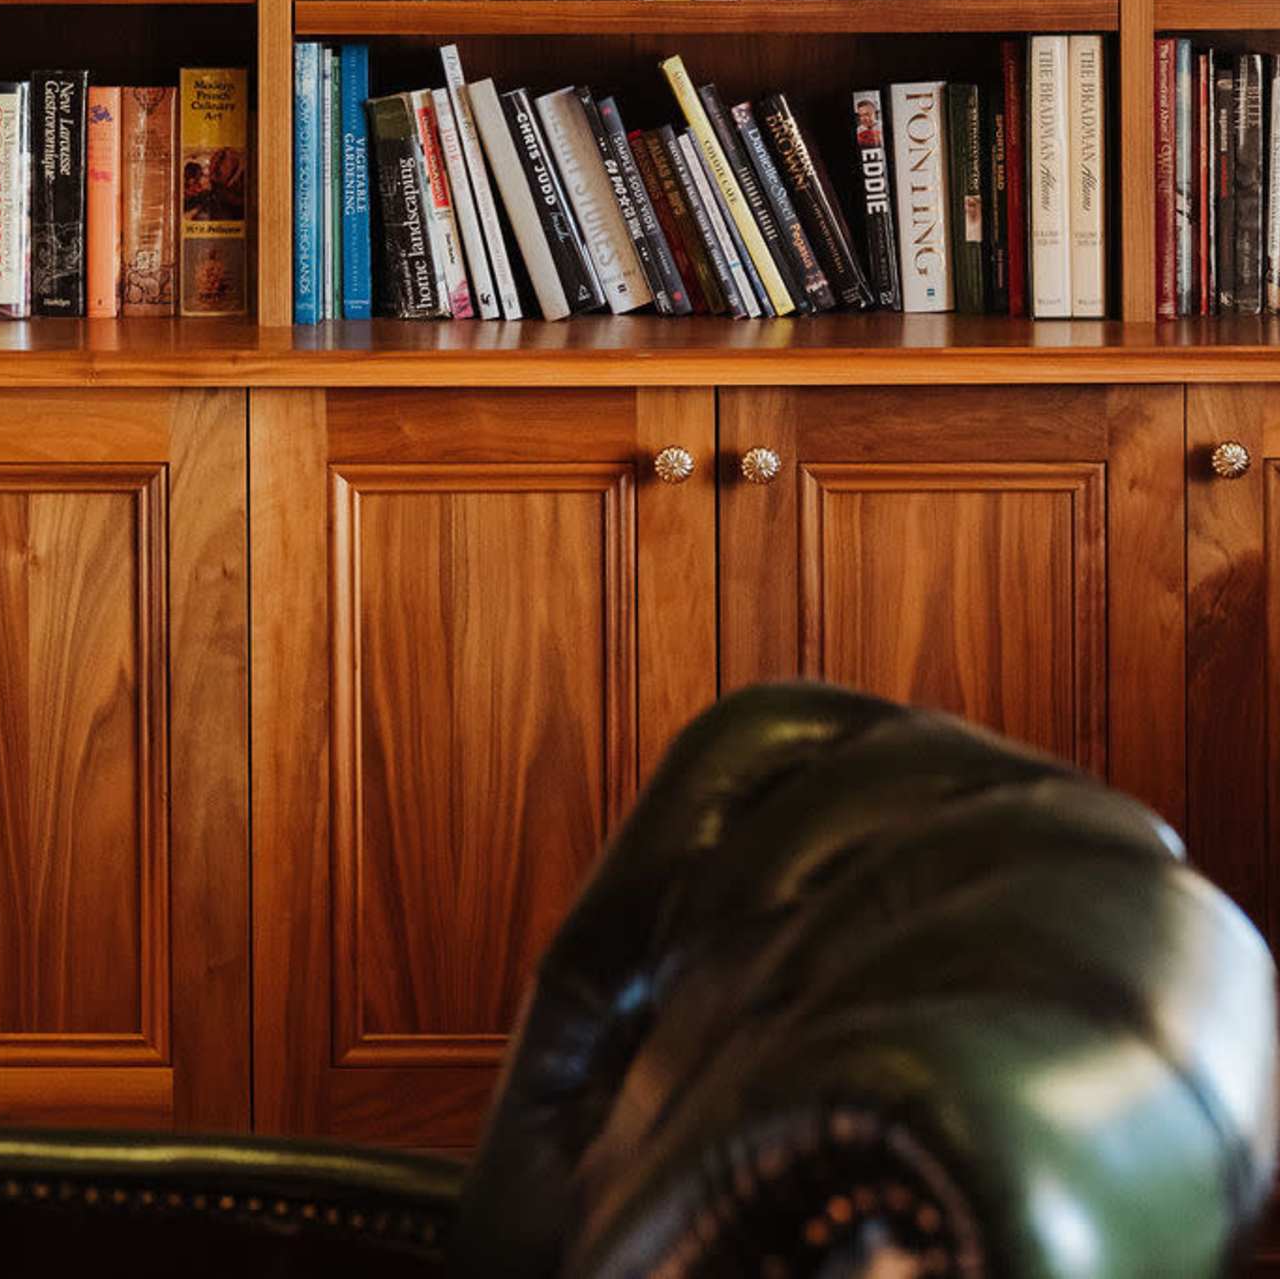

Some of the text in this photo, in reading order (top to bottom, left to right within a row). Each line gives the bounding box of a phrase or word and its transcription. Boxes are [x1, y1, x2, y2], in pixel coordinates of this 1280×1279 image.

[40, 80, 60, 184] Gastronomique
[59, 80, 75, 176] New Larousse
[190, 101, 237, 114] Culinary
[203, 113, 224, 122] Art
[1038, 48, 1057, 213] THE BRADMAN Albums
[1080, 48, 1098, 213] THE BRADMAN Albums
[344, 132, 356, 216] GARDENING
[355, 136, 366, 214] VEGETABLE
[516, 112, 557, 206] CHRIS JUDD
[613, 136, 635, 173] SIMPLE
[628, 175, 646, 205] SOUS
[638, 206, 656, 233] VIDE
[702, 139, 731, 179] COYOTE
[861, 147, 888, 216] EDDIE
[905, 90, 938, 276] PONTING
[995, 114, 1005, 192] SPORTS MAD
[399, 157, 426, 258] landscaping
[413, 260, 434, 309] home
[575, 183, 618, 269] STOKES
[747, 128, 815, 271] Danielle Steel Pegasus
[300, 228, 312, 294] HIGHLANDS
